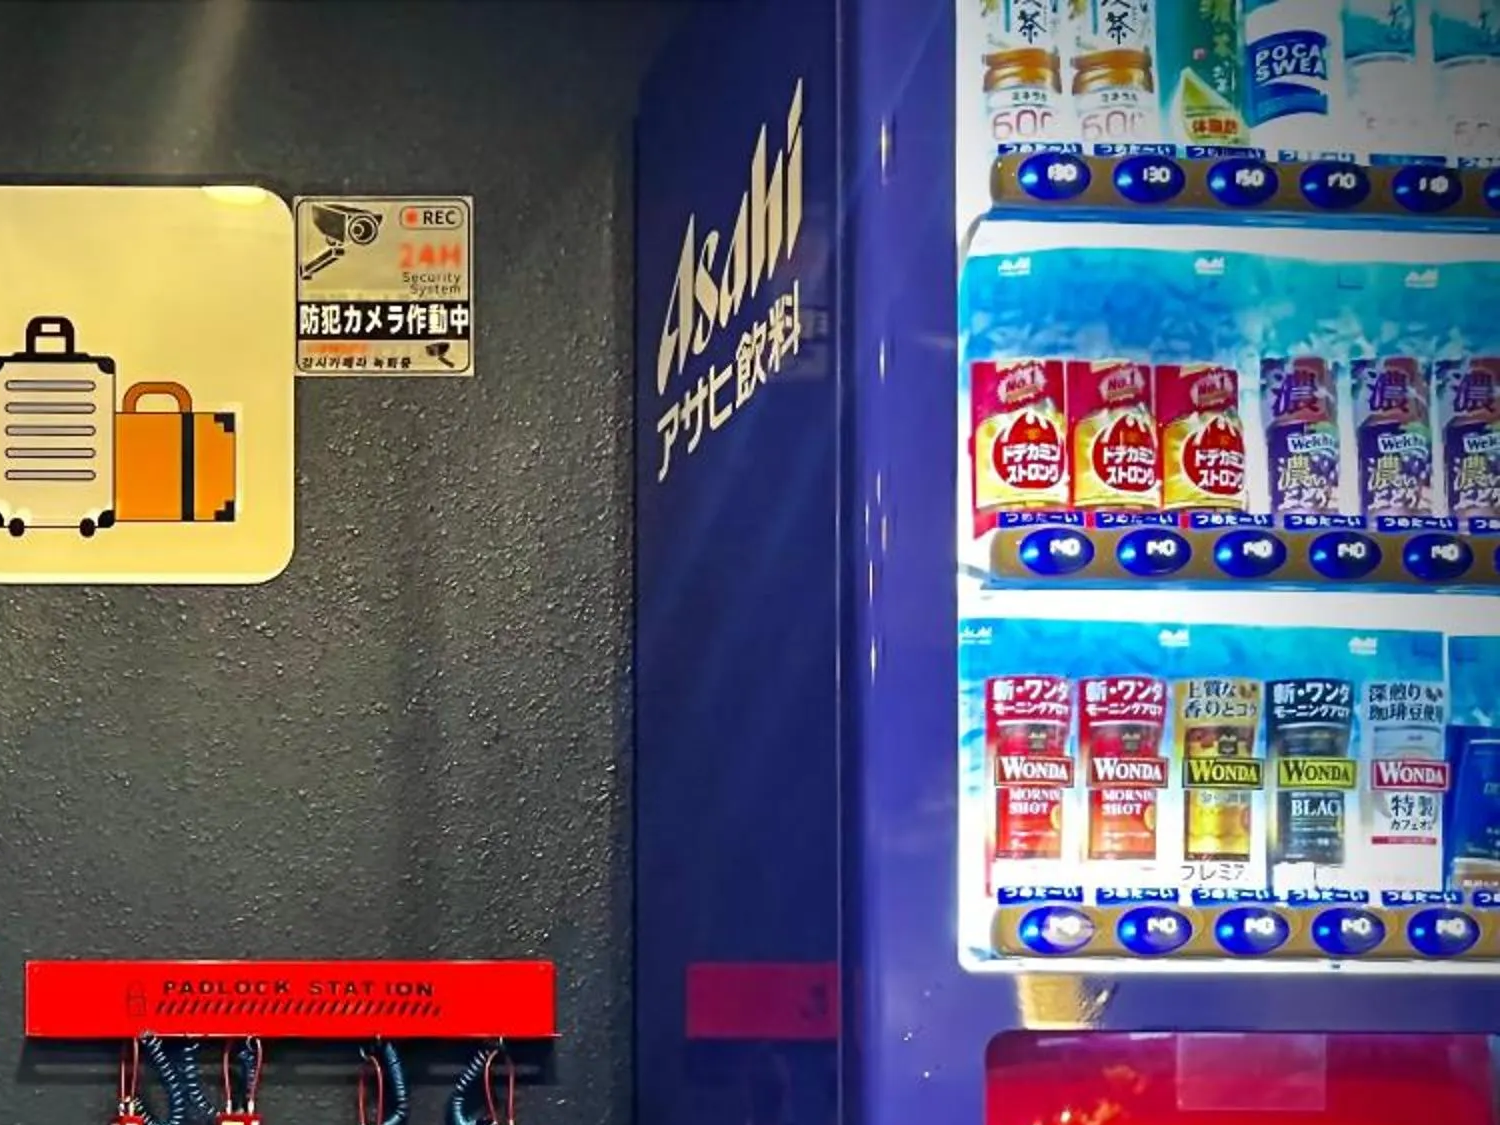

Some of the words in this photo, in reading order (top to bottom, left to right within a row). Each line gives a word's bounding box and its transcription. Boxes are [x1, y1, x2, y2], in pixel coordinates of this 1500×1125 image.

[423, 210, 456, 225] REC
[657, 77, 802, 396] Asahi
[403, 272, 461, 285] Security
[410, 285, 461, 298] System
[300, 303, 469, 335] 防犯カメラ作動中
[657, 280, 801, 482] アサヒ飲料
[1002, 444, 1061, 464] ドデカミン
[1000, 756, 1069, 781] WONDA
[1092, 757, 1163, 781] WONDA
[1189, 759, 1259, 783] WONDA
[1284, 760, 1350, 783] WONDA
[1376, 762, 1445, 785] WONDA
[1009, 802, 1049, 815] SHOT
[1102, 803, 1143, 816] SHOT
[162, 980, 291, 996] PADLOCK
[309, 981, 434, 997] STATION
